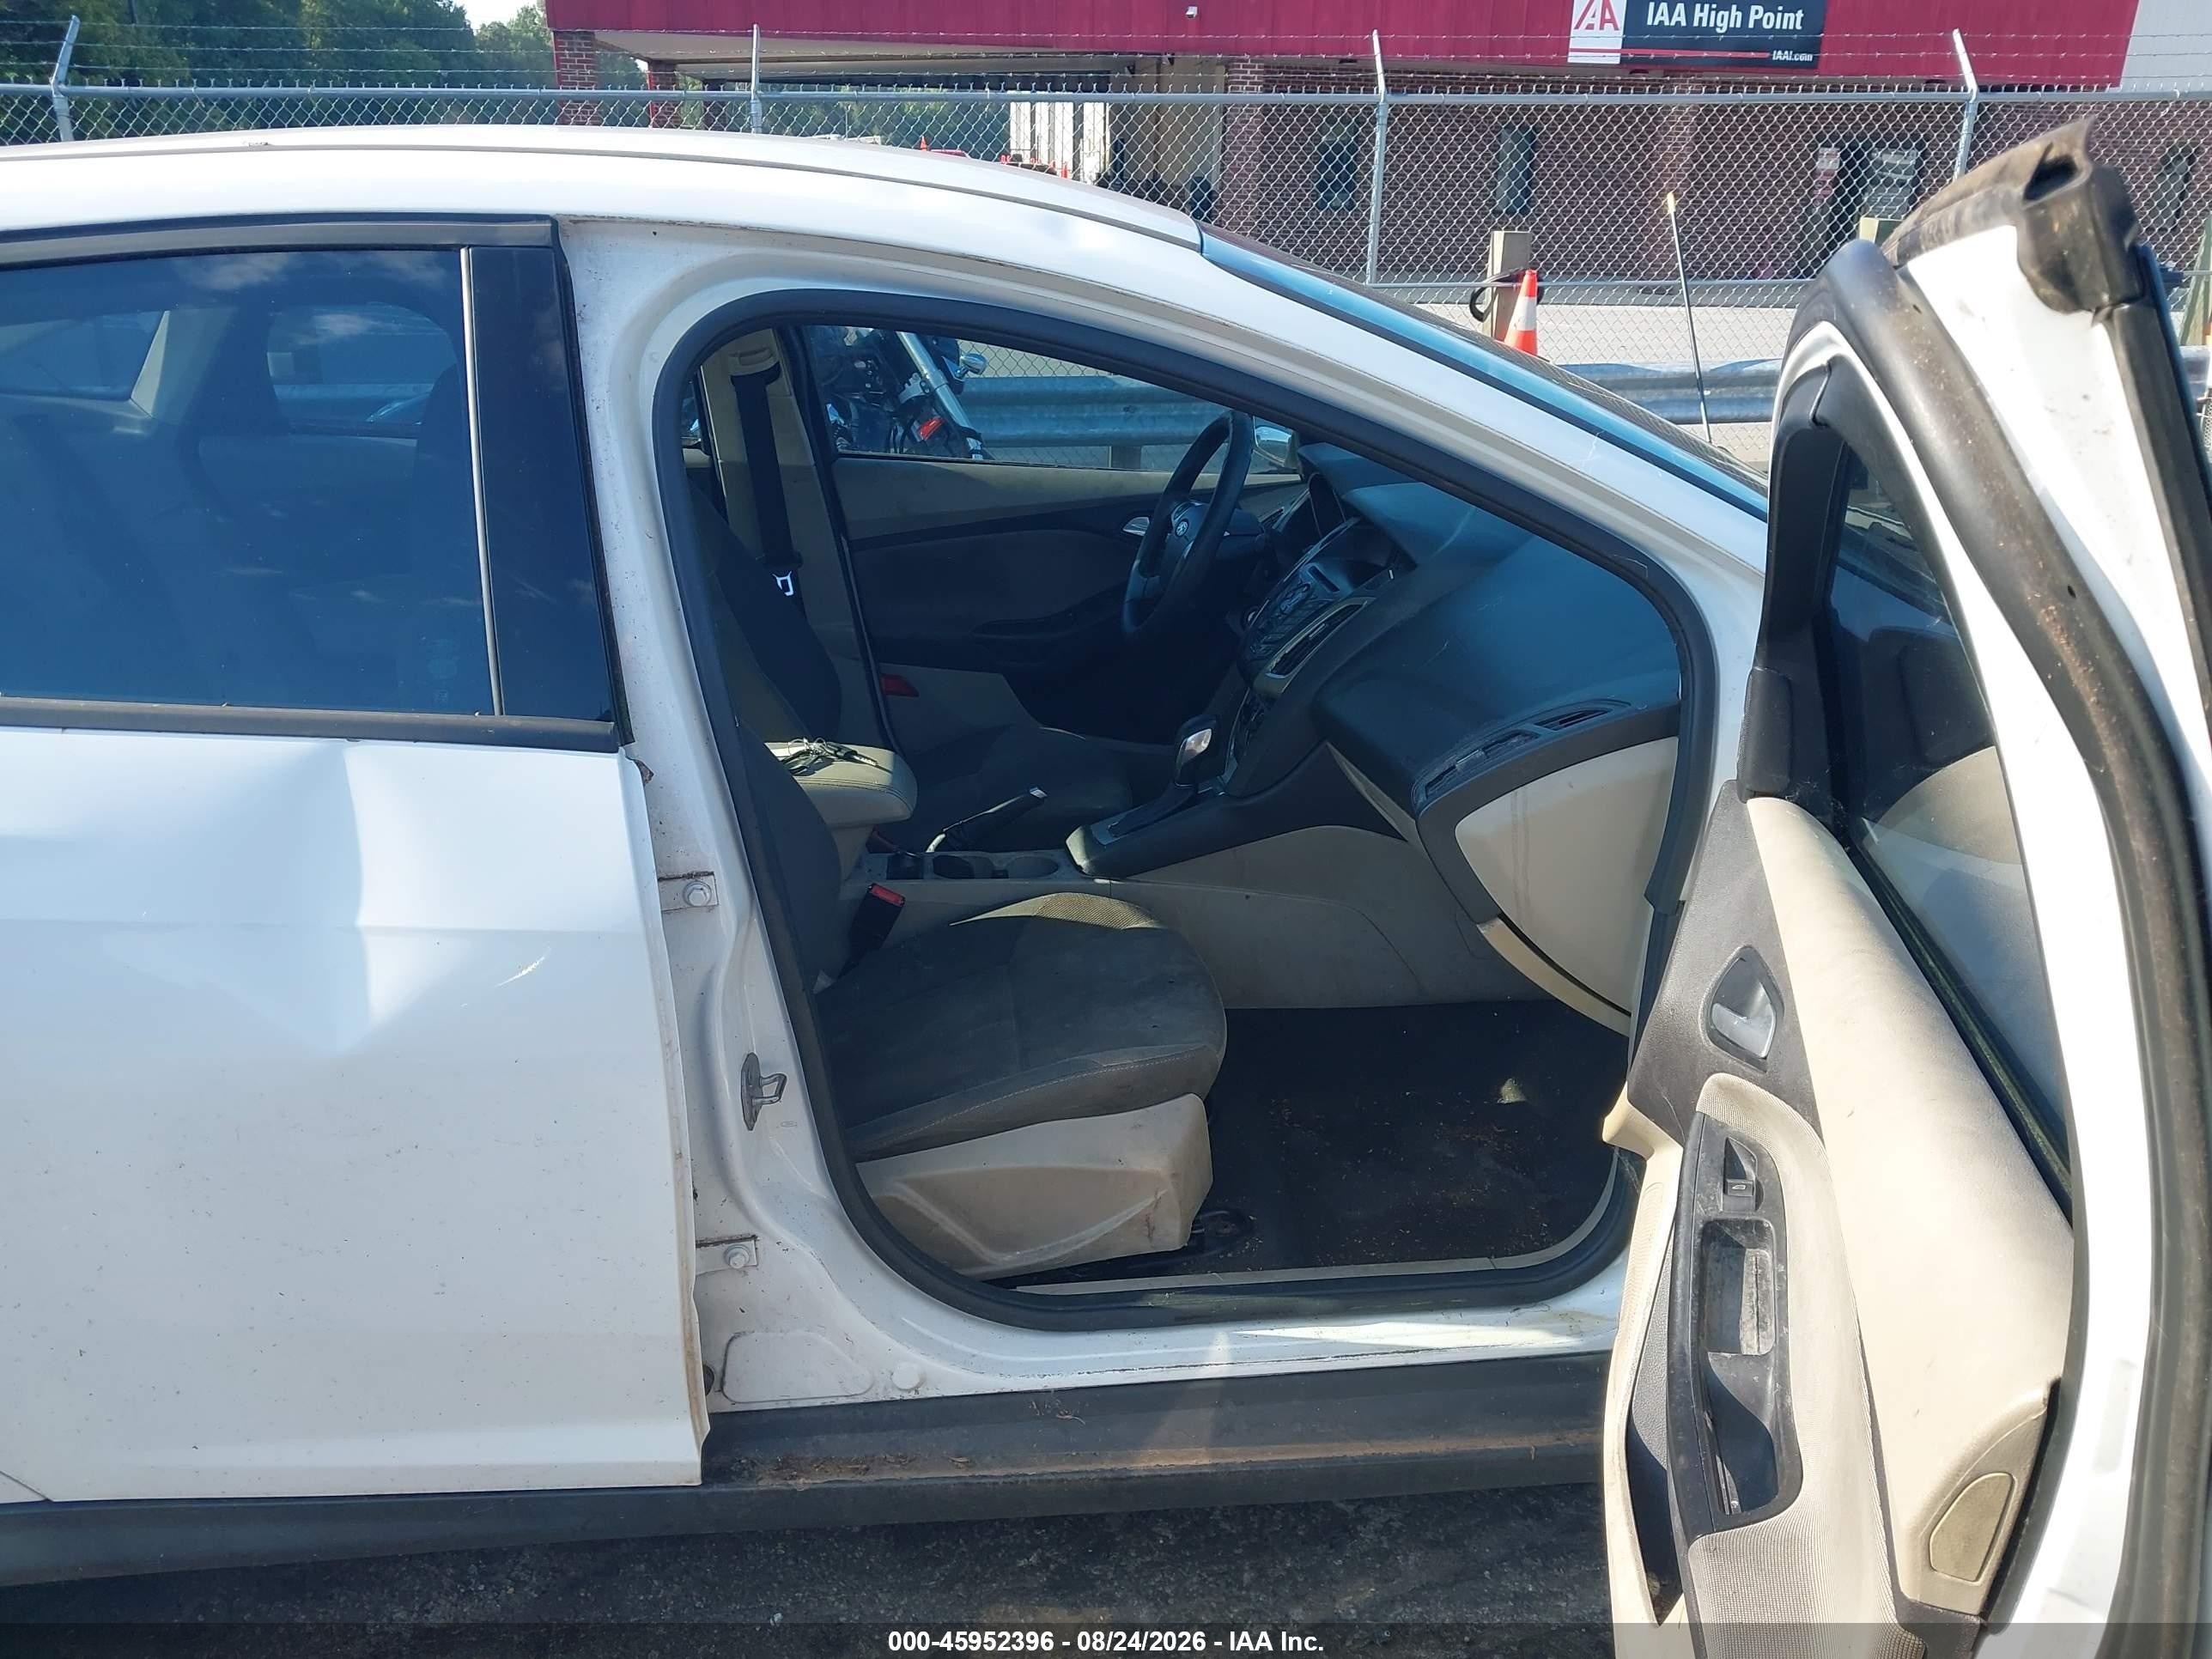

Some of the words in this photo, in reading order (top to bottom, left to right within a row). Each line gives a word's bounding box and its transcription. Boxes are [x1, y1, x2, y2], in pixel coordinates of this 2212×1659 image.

[1646, 1, 1687, 27] IAA
[1692, 3, 1742, 33] High
[1748, 4, 1804, 30] Point
